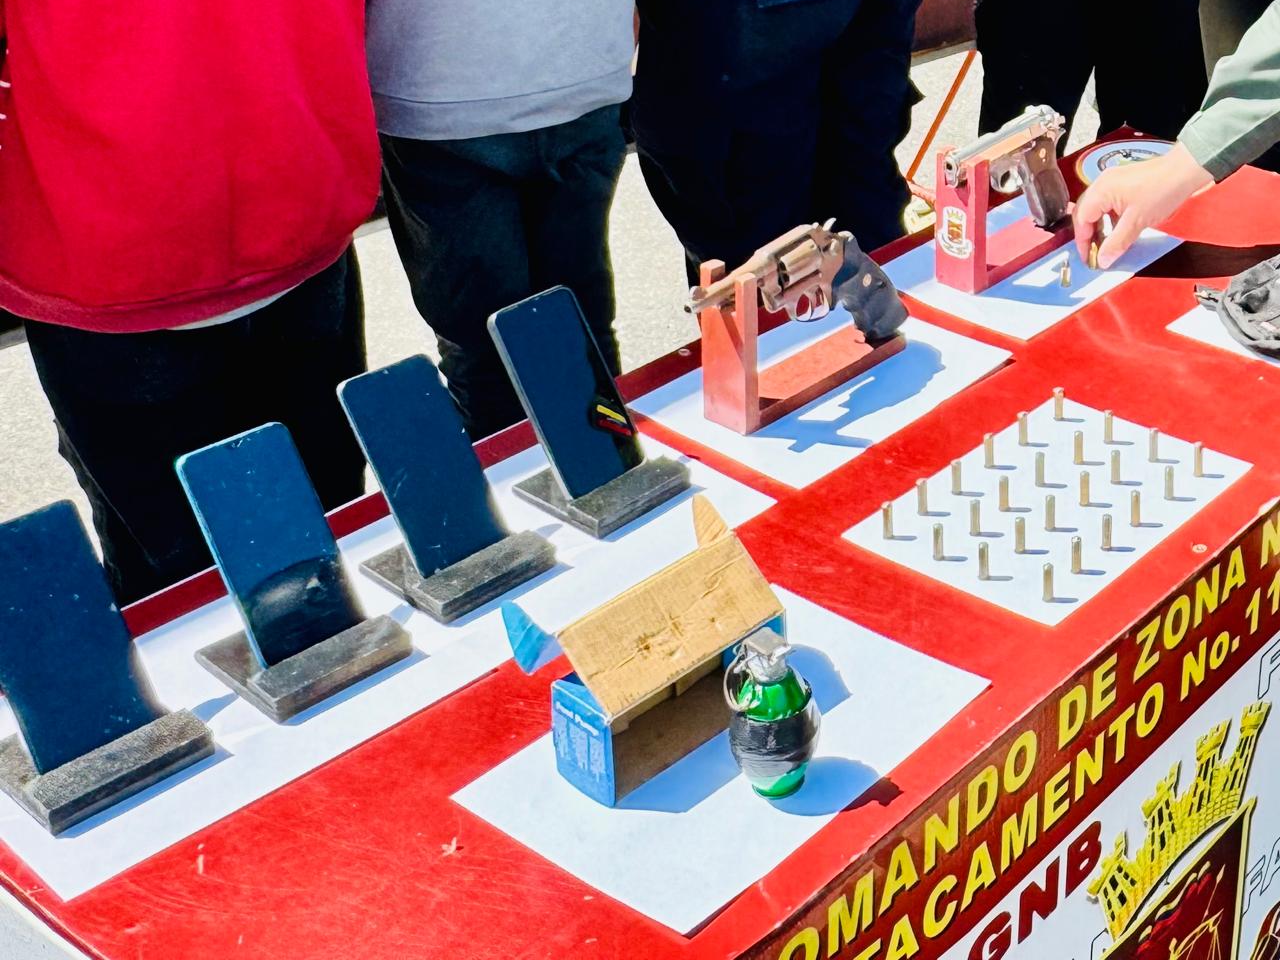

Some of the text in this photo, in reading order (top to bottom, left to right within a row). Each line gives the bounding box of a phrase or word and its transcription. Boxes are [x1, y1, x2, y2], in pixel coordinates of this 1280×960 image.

[1058, 652, 1118, 747] DE
[1133, 545, 1245, 680] ZONA
[1180, 632, 1241, 699] No.
